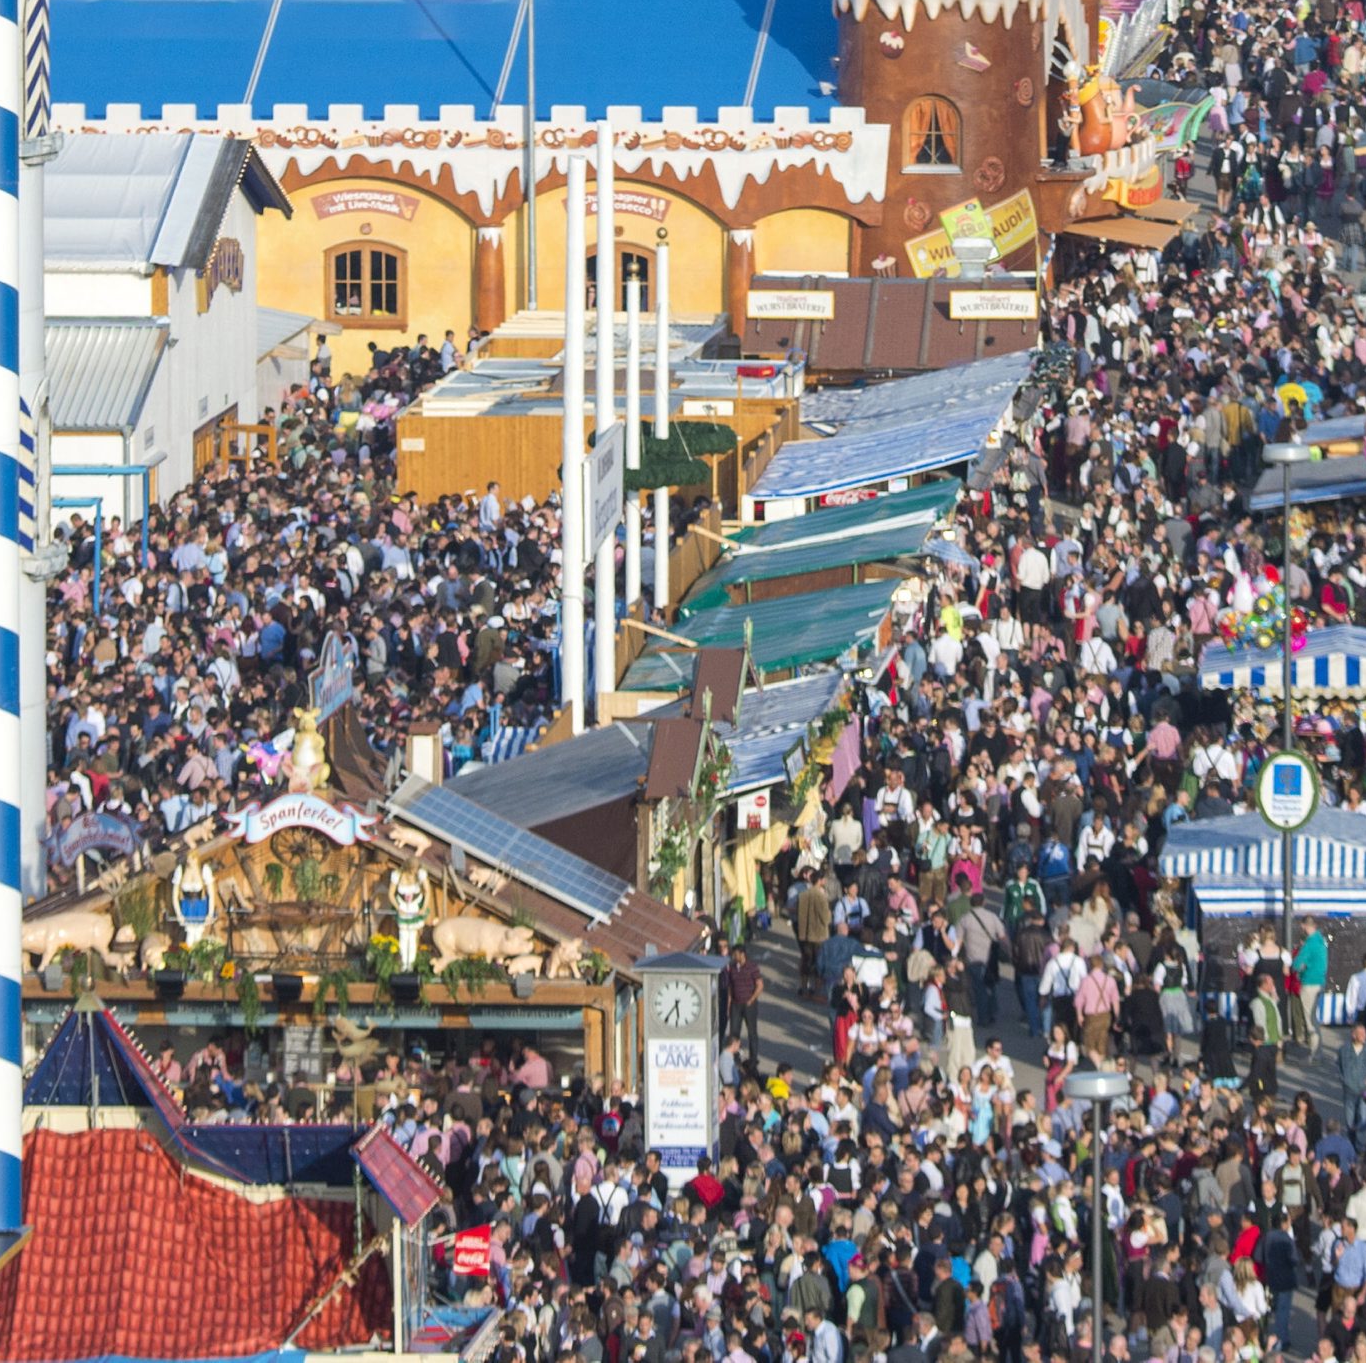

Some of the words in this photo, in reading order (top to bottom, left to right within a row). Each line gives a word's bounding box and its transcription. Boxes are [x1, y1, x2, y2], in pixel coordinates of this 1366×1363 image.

[332, 192, 395, 205] Wiesngaudi
[328, 204, 346, 215] mit
[348, 200, 401, 215] Live-Musik
[259, 802, 344, 830] Spanferkel
[655, 1053, 700, 1069] LANG
